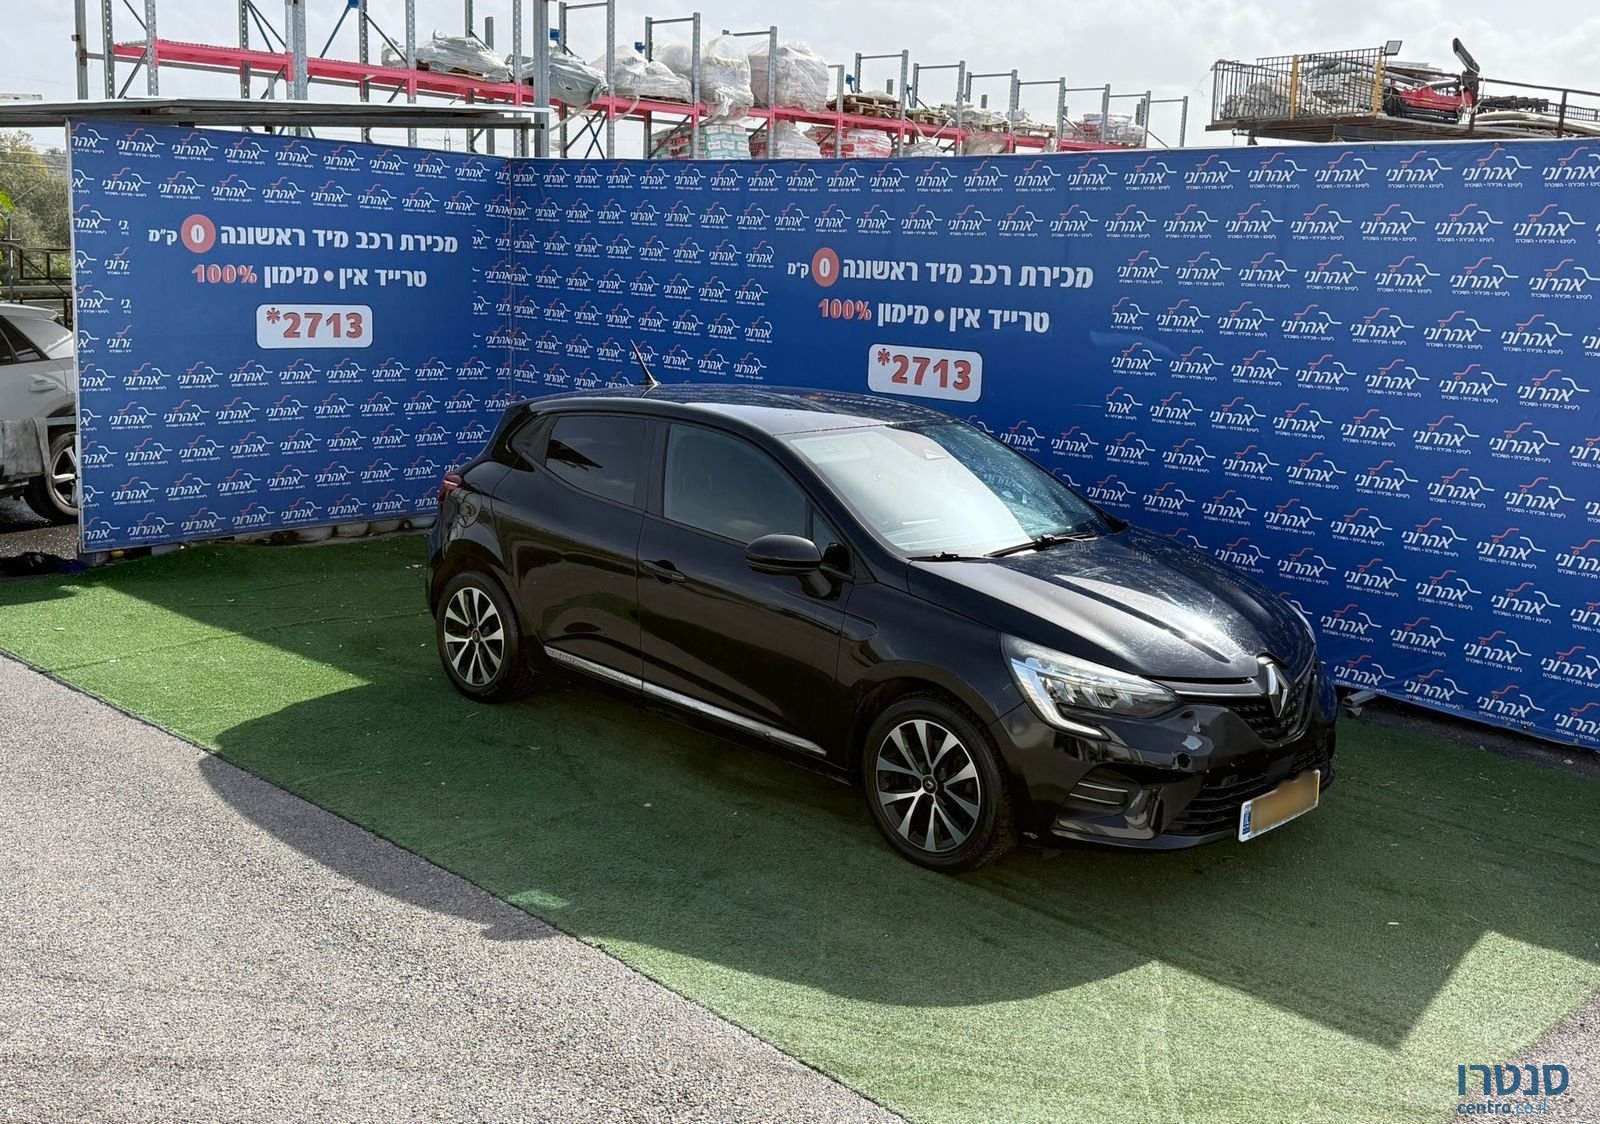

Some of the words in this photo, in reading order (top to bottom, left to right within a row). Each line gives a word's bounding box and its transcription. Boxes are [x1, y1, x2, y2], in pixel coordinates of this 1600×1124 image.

[116, 139, 155, 153] אהרוני
[171, 144, 209, 156] אהרוני
[224, 148, 260, 160] אהרוני
[275, 151, 310, 163] אהרוני
[323, 155, 356, 167] אהרוני
[1067, 173, 1107, 185] אהרוני
[1123, 172, 1166, 185] אהרוני
[1184, 171, 1229, 184] אהרוני
[1247, 169, 1295, 182] אהרוני
[1314, 168, 1365, 182] אהרוני
[1386, 168, 1439, 182] אהרוני
[1462, 167, 1518, 181] אהרוני
[1542, 165, 1600, 180] אהרוני
[101, 179, 143, 192] אהרוני
[786, 175, 816, 187] אהרוני
[826, 176, 857, 187] אהרוני
[963, 175, 999, 187] אהרוני
[1013, 175, 1051, 186] אהרוני
[158, 183, 196, 195] אהרוני
[211, 186, 247, 198] אהרוני
[310, 191, 344, 203] אהרוני
[535, 208, 557, 218] אהרוני
[565, 209, 589, 219] אהרוני
[997, 220, 1034, 232] אהרוני
[1049, 220, 1089, 232] אהרוני
[1104, 220, 1146, 232] אהרוני
[1163, 220, 1207, 233] אהרוני
[1225, 220, 1272, 233] אהרוני
[1290, 221, 1339, 234] אהרוני
[1360, 220, 1412, 235] אהרוני
[1434, 221, 1489, 235] אהרוני
[1513, 223, 1571, 237] אהרוני
[148, 229, 178, 245] ק"מ
[191, 224, 205, 244] 0
[220, 226, 305, 246] ראשונה
[312, 229, 349, 248] מיד
[355, 231, 393, 250] רכב
[399, 234, 458, 253] מכירת
[574, 243, 598, 253] אהרוני
[708, 251, 735, 261] אהרוני
[191, 263, 258, 284] 100%
[787, 262, 809, 279] ק"מ
[819, 257, 831, 277] 0
[843, 259, 918, 281] ראשונה
[925, 262, 962, 283] מיד
[1117, 266, 1158, 278] אהרוני
[1176, 267, 1220, 280] אהרוני
[264, 266, 319, 288] מימון
[339, 268, 368, 290] אין
[374, 269, 427, 287] טרייד
[969, 264, 1012, 286] רכב
[1018, 266, 1093, 288] מכירת
[1238, 268, 1285, 282] אהרוני
[1304, 269, 1354, 284] אהרוני
[1374, 272, 1427, 287] אהרוני
[1449, 275, 1504, 289] אהרוני
[1528, 277, 1587, 292] אהרוני
[574, 311, 597, 321] אהרוני
[818, 298, 872, 321] 100%
[877, 303, 929, 327] מימון
[605, 314, 630, 325] אהרוני
[949, 307, 981, 332] אין
[988, 309, 1050, 333] טרייד
[1156, 314, 1199, 327] אהרוני
[1217, 317, 1263, 331] אהרוני
[1281, 320, 1329, 334] אהרוני
[1350, 323, 1401, 338] אהרוני
[1423, 327, 1477, 342] אהרוני
[1500, 331, 1558, 347] אהרוני
[1111, 356, 1152, 370] אהרוני
[1169, 360, 1213, 375] אהרוני
[326, 369, 359, 379] אהרוני
[371, 369, 403, 378] אהרוני
[1230, 365, 1277, 379] אהרוני
[1295, 369, 1344, 385] אהרוני
[122, 375, 161, 386] אהרוני
[1365, 374, 1416, 390] אהרוני
[1439, 380, 1493, 396] אהרוני
[1517, 385, 1575, 402] אהרוני
[359, 403, 391, 413] אהרוני
[1149, 405, 1192, 420] אהרוני
[108, 413, 148, 425] אהרוני
[163, 412, 200, 423] אהרוני
[1209, 411, 1255, 426] אהרוני
[1272, 417, 1320, 433] אהרוני
[414, 433, 444, 443] אהרוני
[455, 431, 484, 440] אהרוני
[1340, 423, 1391, 440] אהרוני
[1412, 430, 1466, 447] אהרוני
[178, 446, 215, 458] אהרוני
[279, 440, 313, 451] אהרוני
[1051, 438, 1089, 453] אהרוני
[1105, 444, 1145, 459] אהרוני
[1489, 437, 1545, 455] אהרוני
[125, 449, 164, 462] אהרוני
[1162, 451, 1205, 466] אהרוני
[403, 466, 433, 477] אהרוני
[1222, 458, 1268, 474] אהרוני
[314, 471, 348, 483] אהרוני
[1286, 466, 1334, 482] אהרוני
[217, 480, 252, 492] אהרוני
[1354, 474, 1405, 491] אהרוני
[111, 487, 150, 501] אהרוני
[165, 484, 202, 497] אהרוני
[1086, 486, 1126, 502] אהרוני
[1427, 482, 1481, 500] אהרוני
[1143, 494, 1184, 510] אהרוני
[1504, 491, 1561, 510] אהרוני
[280, 507, 315, 520] אהרוני
[1201, 502, 1246, 519] אהרוני
[180, 517, 218, 531] אהרוני
[231, 512, 267, 526] אהרוני
[1263, 511, 1310, 528] אהרוני
[127, 522, 166, 536] אהרוני
[1330, 521, 1380, 539] אהרוני
[1401, 531, 1454, 549] אהרוני
[1476, 541, 1532, 561] אהרוני
[1277, 559, 1324, 577] אהרוני
[1344, 570, 1394, 589] אהרוני
[1415, 582, 1468, 602] אהרוני
[1491, 595, 1546, 615] אהרוני
[1320, 615, 1369, 635] אהרוני
[1390, 629, 1441, 649] אהרוני
[1463, 643, 1518, 664] אהרוני
[1334, 665, 1382, 686] אהרוני
[1540, 657, 1598, 680] אהרוני
[1403, 680, 1455, 701] אהרוני
[1477, 696, 1531, 718] אהרוני
